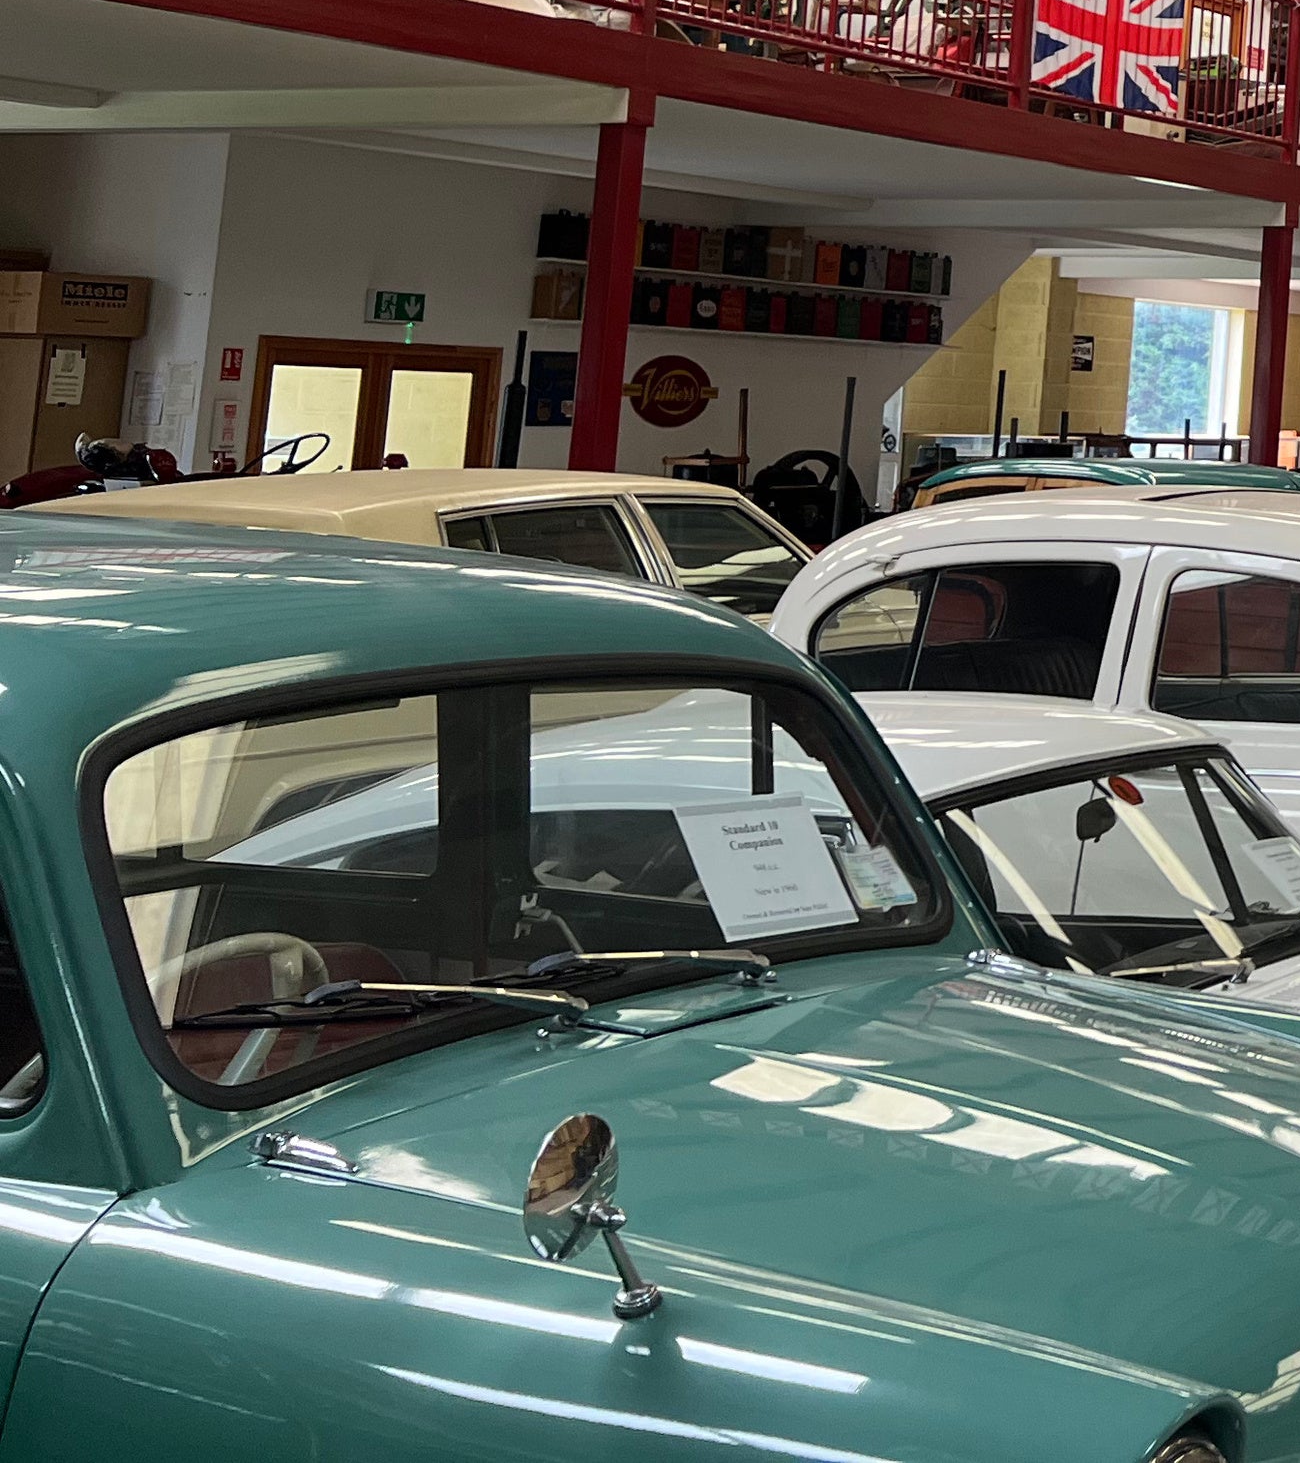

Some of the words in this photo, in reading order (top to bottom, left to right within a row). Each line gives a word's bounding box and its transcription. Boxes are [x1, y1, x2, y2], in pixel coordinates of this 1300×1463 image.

[64, 283, 126, 298] Miele
[641, 367, 695, 411] Villiers
[721, 821, 766, 836] Standard
[767, 820, 779, 831] 10
[729, 837, 784, 851] Companion
